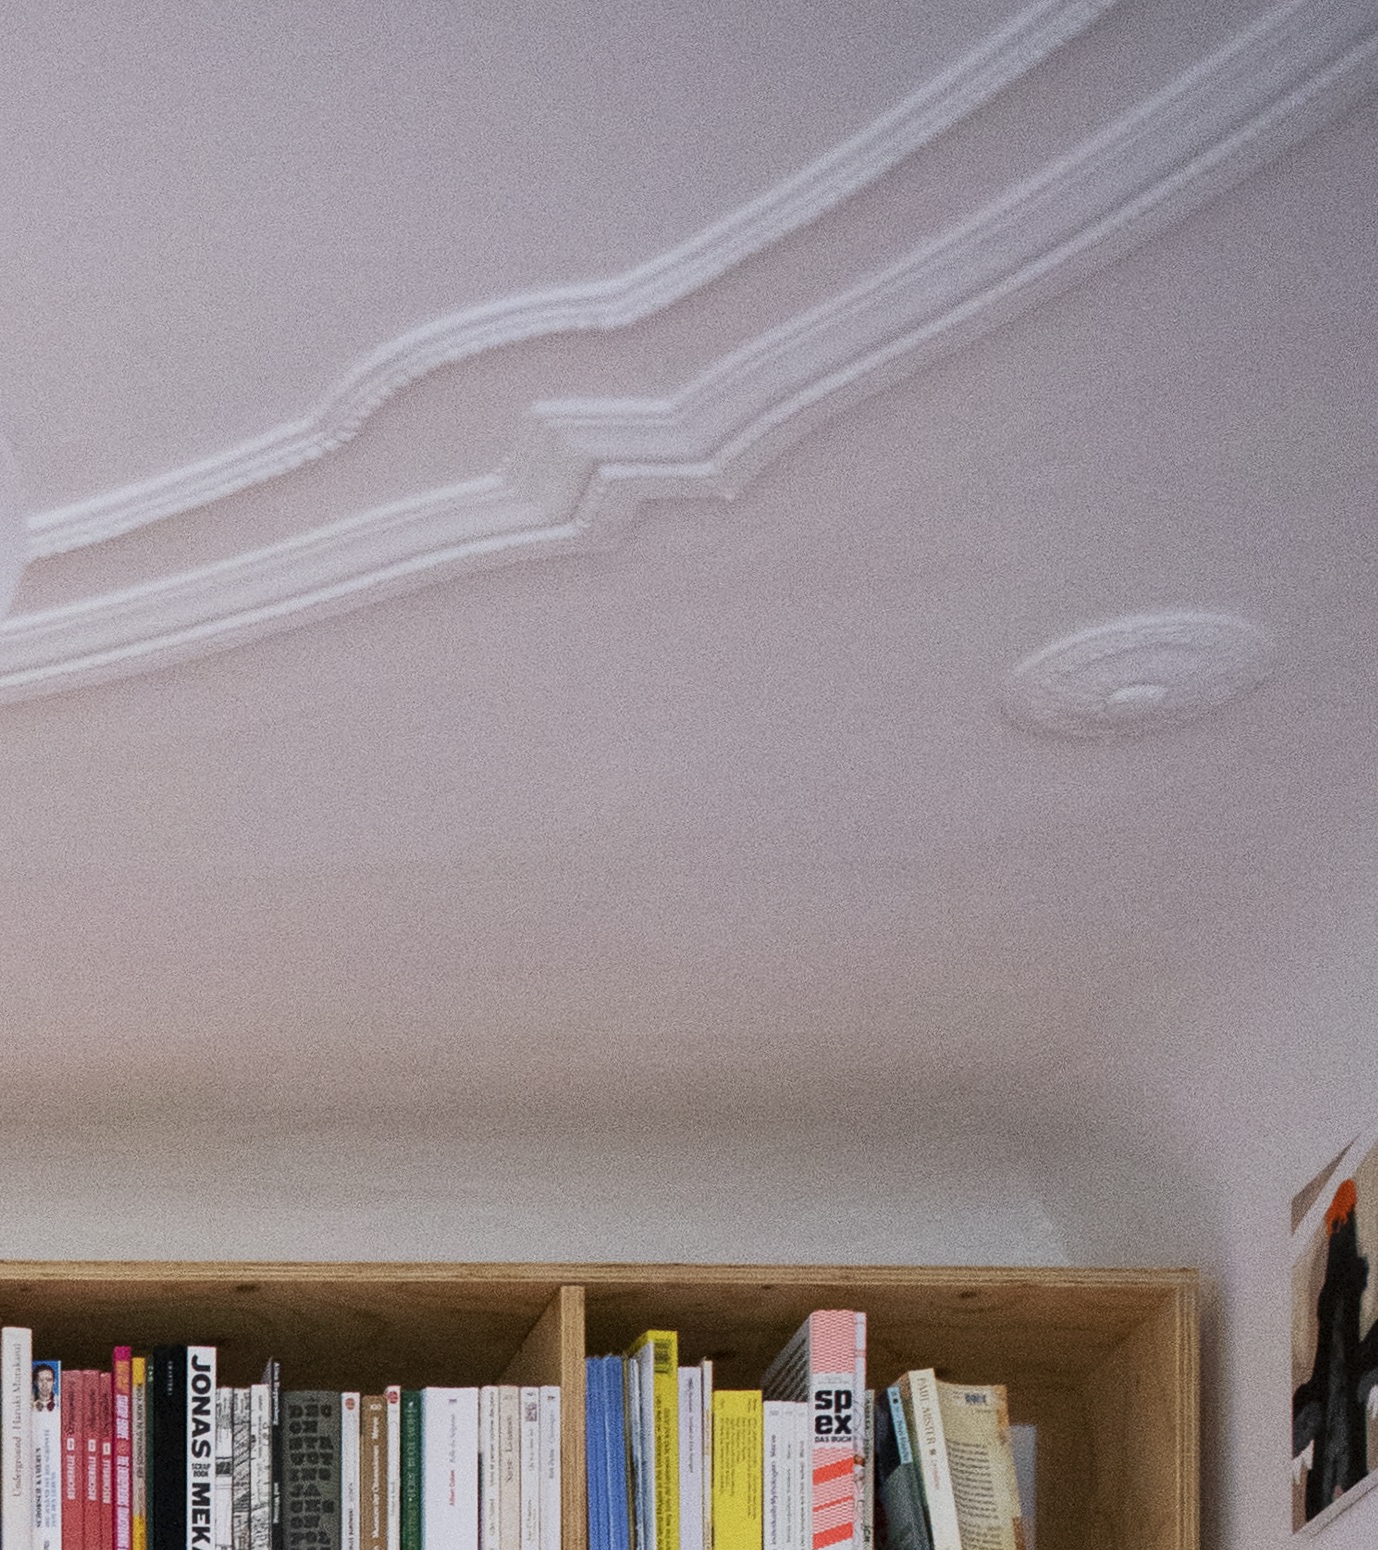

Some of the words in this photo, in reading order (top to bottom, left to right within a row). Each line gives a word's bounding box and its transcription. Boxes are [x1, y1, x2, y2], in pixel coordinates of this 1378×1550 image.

[191, 1353, 211, 1458] JONAS
[814, 1389, 853, 1413] sp
[814, 1413, 853, 1435] ex
